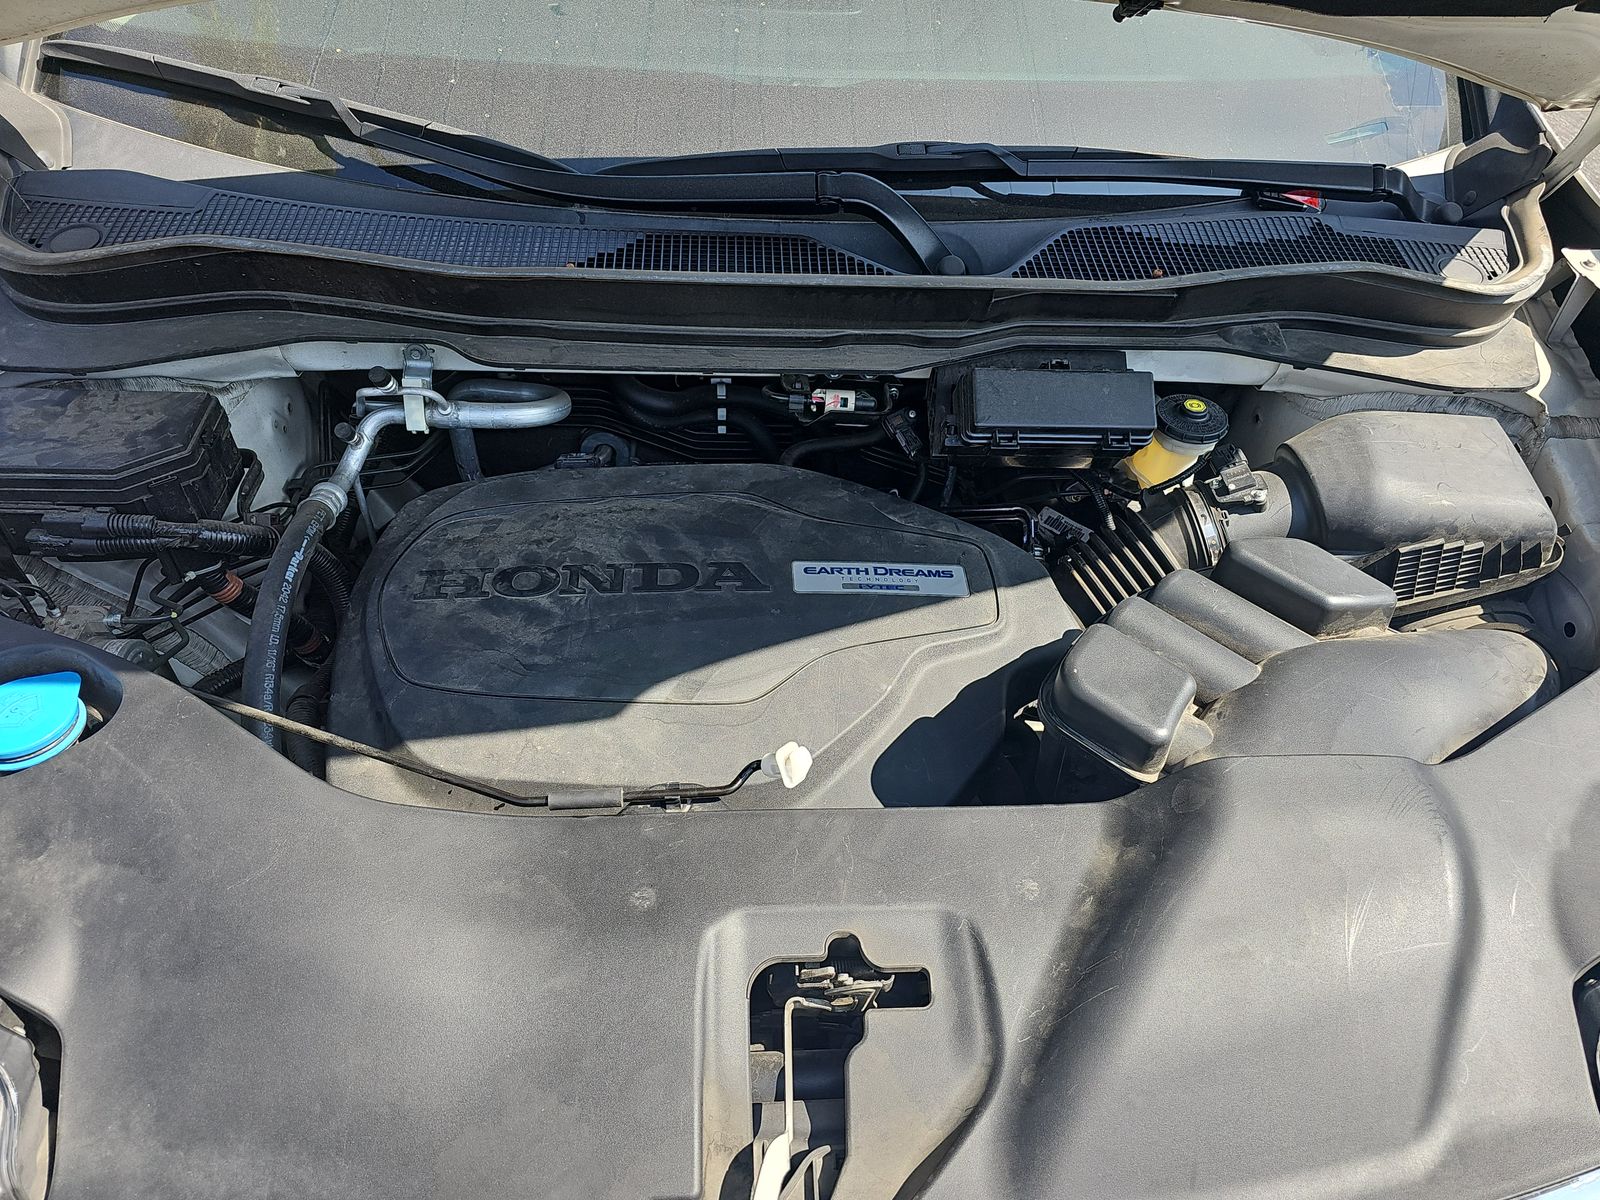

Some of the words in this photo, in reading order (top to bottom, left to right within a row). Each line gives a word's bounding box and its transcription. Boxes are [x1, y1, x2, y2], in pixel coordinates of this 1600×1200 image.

[284, 550, 304, 582] Parker
[803, 566, 870, 576] EARTH
[873, 566, 954, 578] DREAMS
[412, 561, 773, 602] HONDA
[841, 576, 919, 584] TECHNOLOGY
[279, 581, 292, 604] 2042
